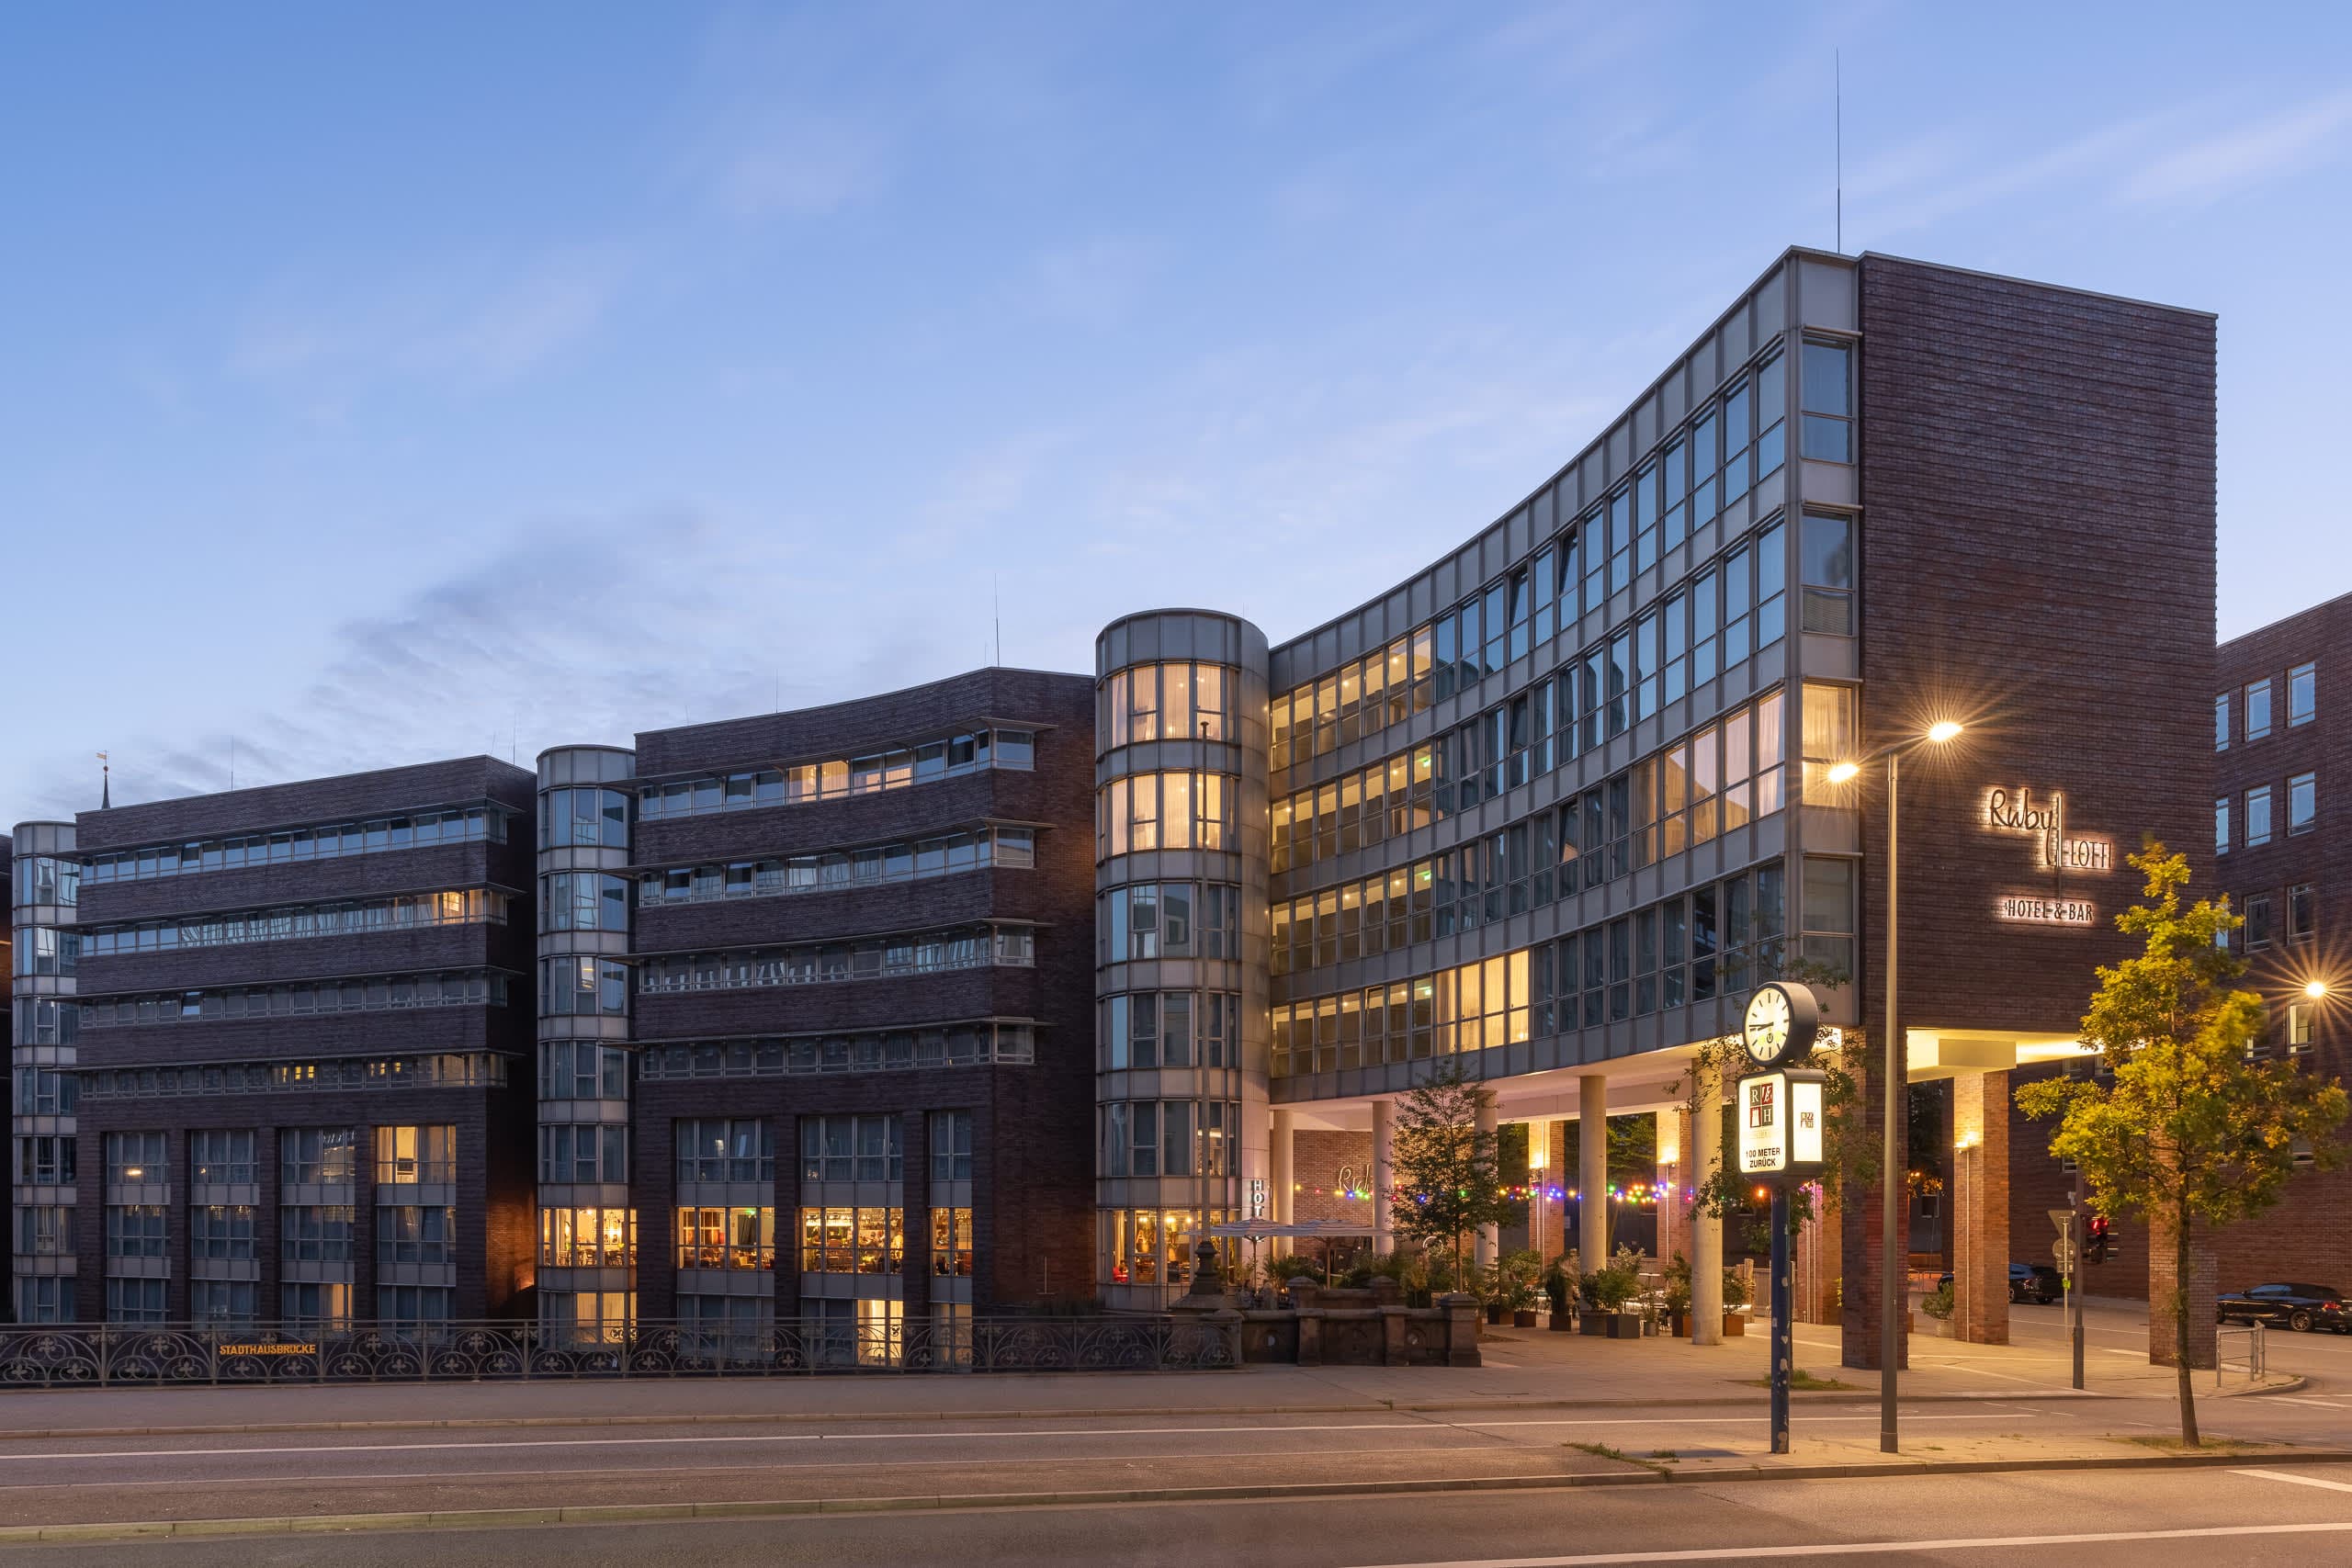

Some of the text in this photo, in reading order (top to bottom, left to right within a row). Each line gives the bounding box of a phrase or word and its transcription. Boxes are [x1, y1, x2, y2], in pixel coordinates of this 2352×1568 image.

[1990, 789, 2053, 865] Ruby
[2071, 840, 2111, 868] LOTTI
[2007, 899, 2093, 920] HOTEL & BAR
[1747, 1147, 1781, 1157] 100 METER
[1749, 1157, 1776, 1168] ZURÜCK
